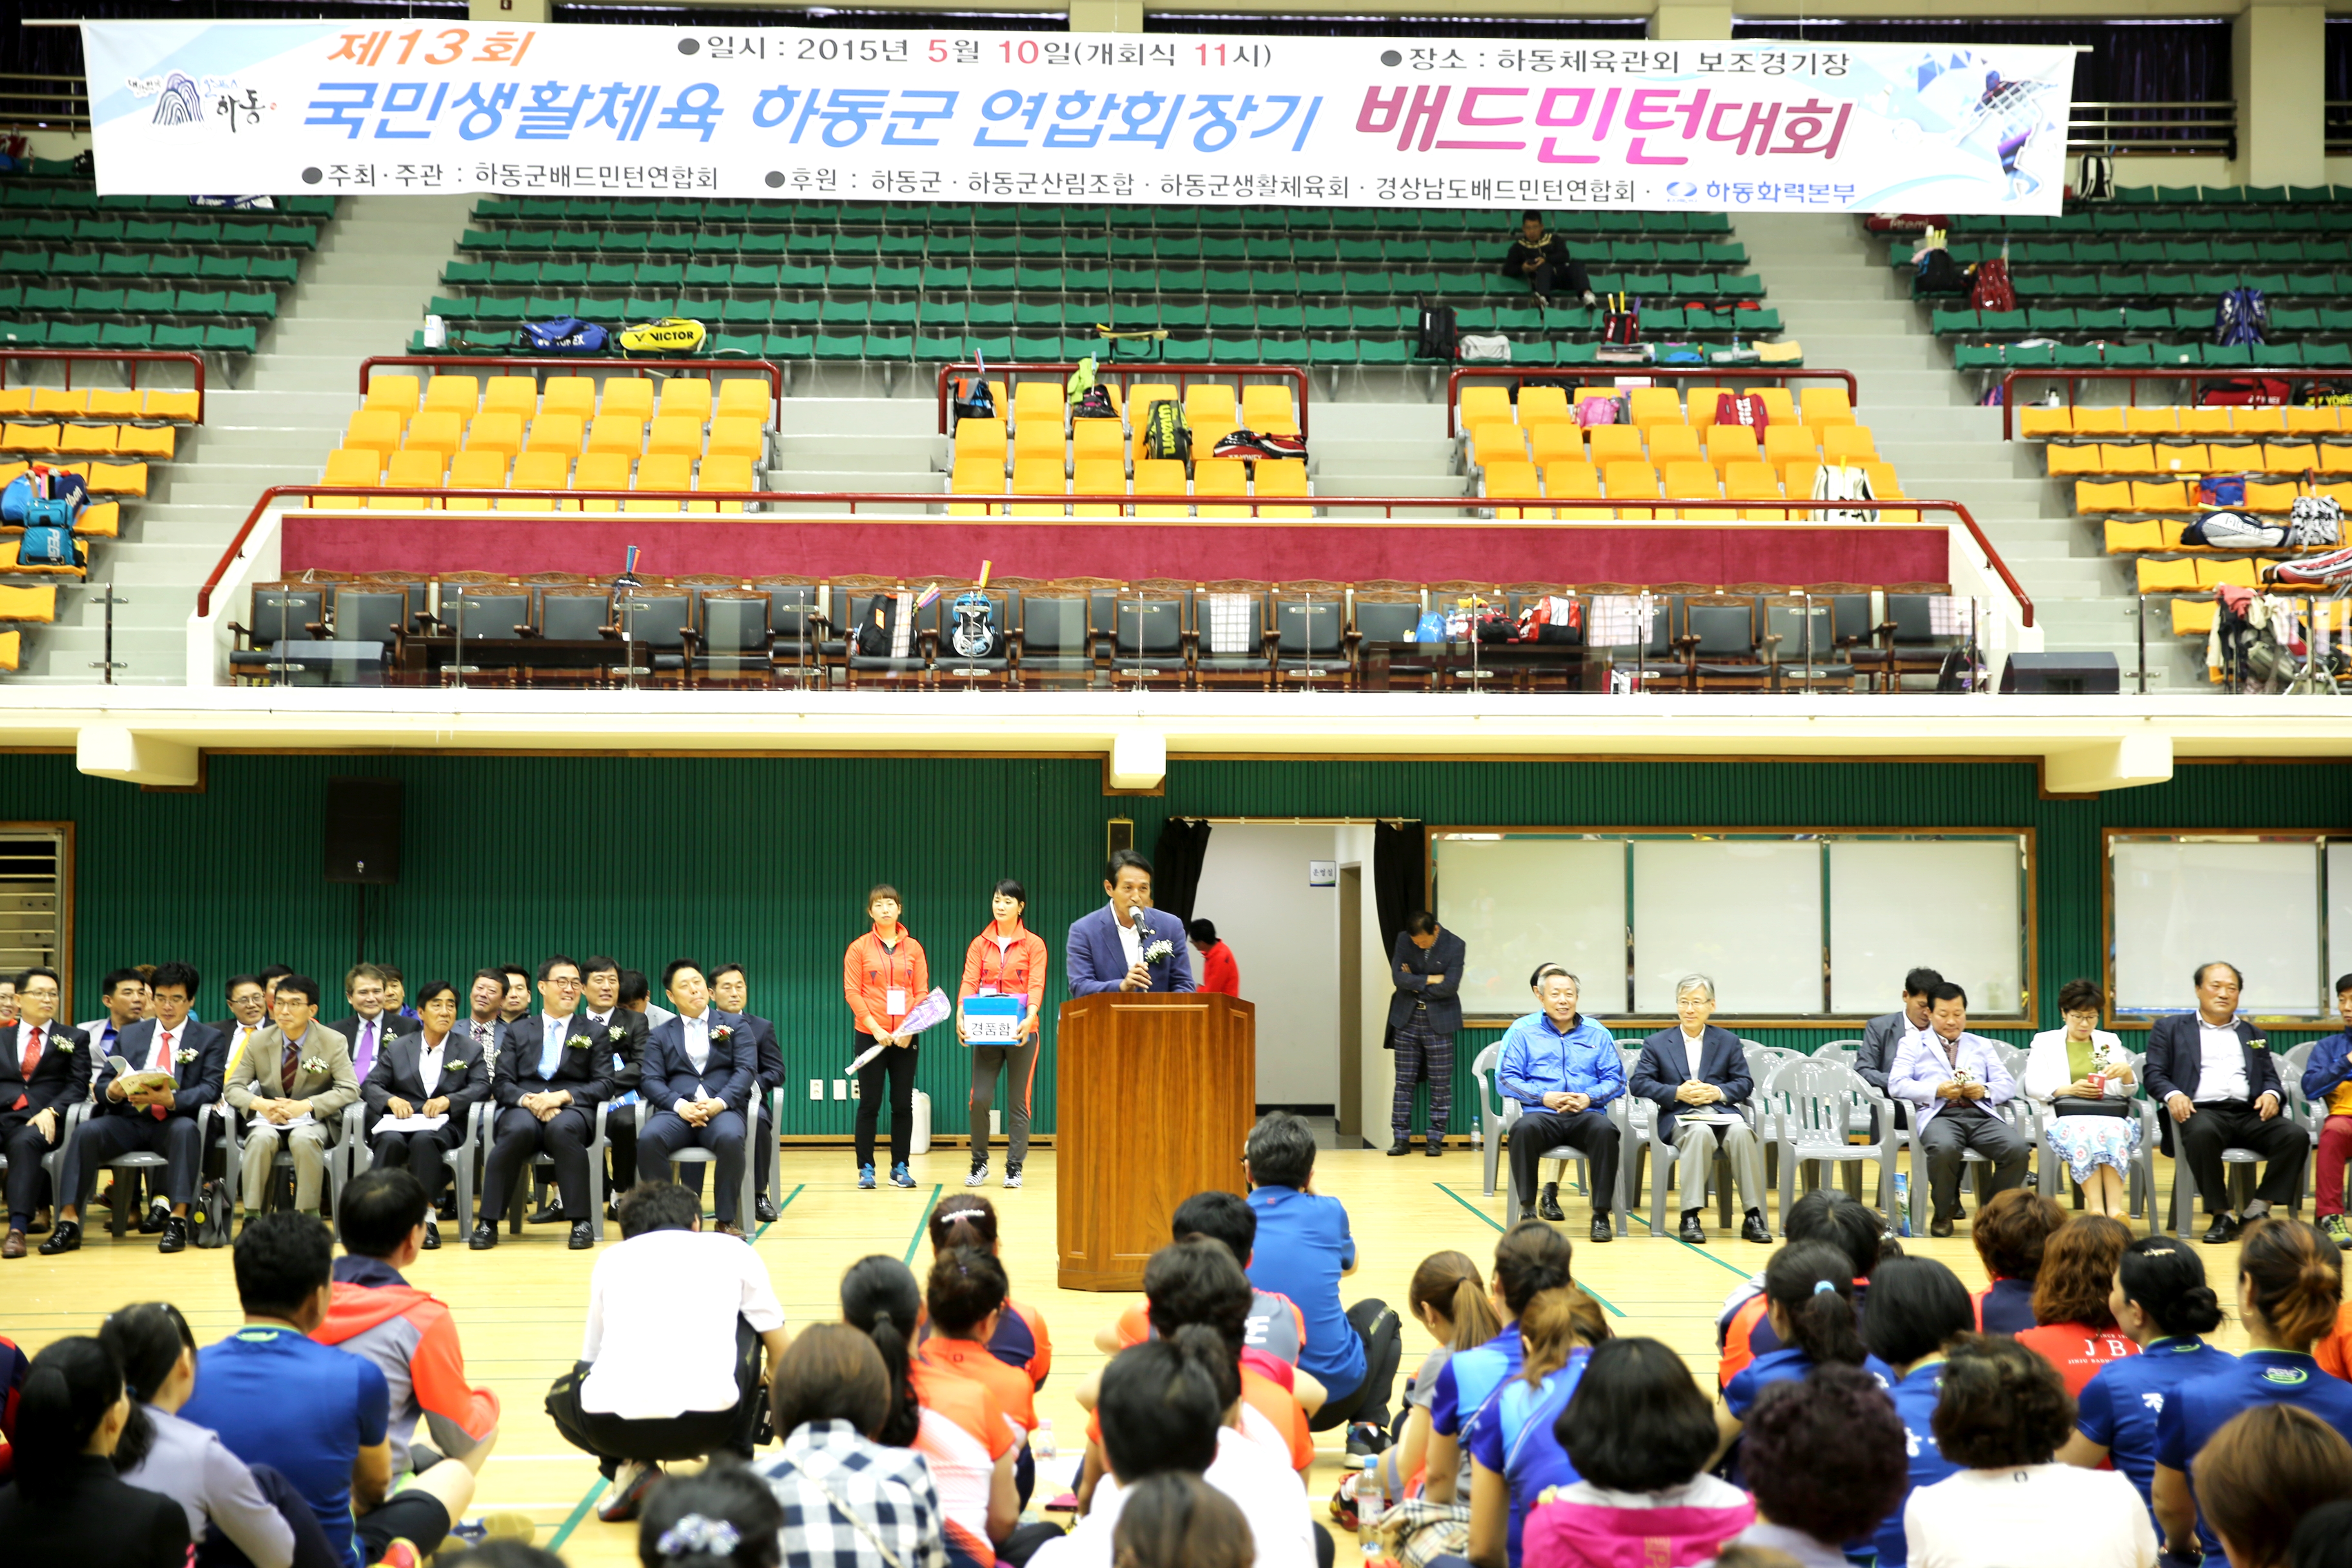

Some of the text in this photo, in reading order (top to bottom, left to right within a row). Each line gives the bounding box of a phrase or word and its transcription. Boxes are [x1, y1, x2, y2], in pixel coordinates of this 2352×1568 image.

[328, 29, 535, 66] 제13회
[708, 37, 764, 59] 일시
[798, 39, 907, 61] 2015년
[929, 40, 978, 62] 5월
[1196, 44, 1270, 67] 11시)
[1410, 48, 1466, 70] 장소
[1498, 50, 1677, 73] 하동체육관외
[1697, 53, 1849, 76] 보조경기장
[217, 89, 265, 133] 하동
[304, 81, 1853, 165] 국민생활체육 하동군 연합회장기 배드민턴대회
[475, 163, 716, 189] 하동군배드민턴연합회
[791, 169, 835, 191] 후원
[1707, 181, 1854, 203] 하동화력본부
[649, 331, 694, 341] VICTOR
[971, 1022, 1011, 1036] 경품함
